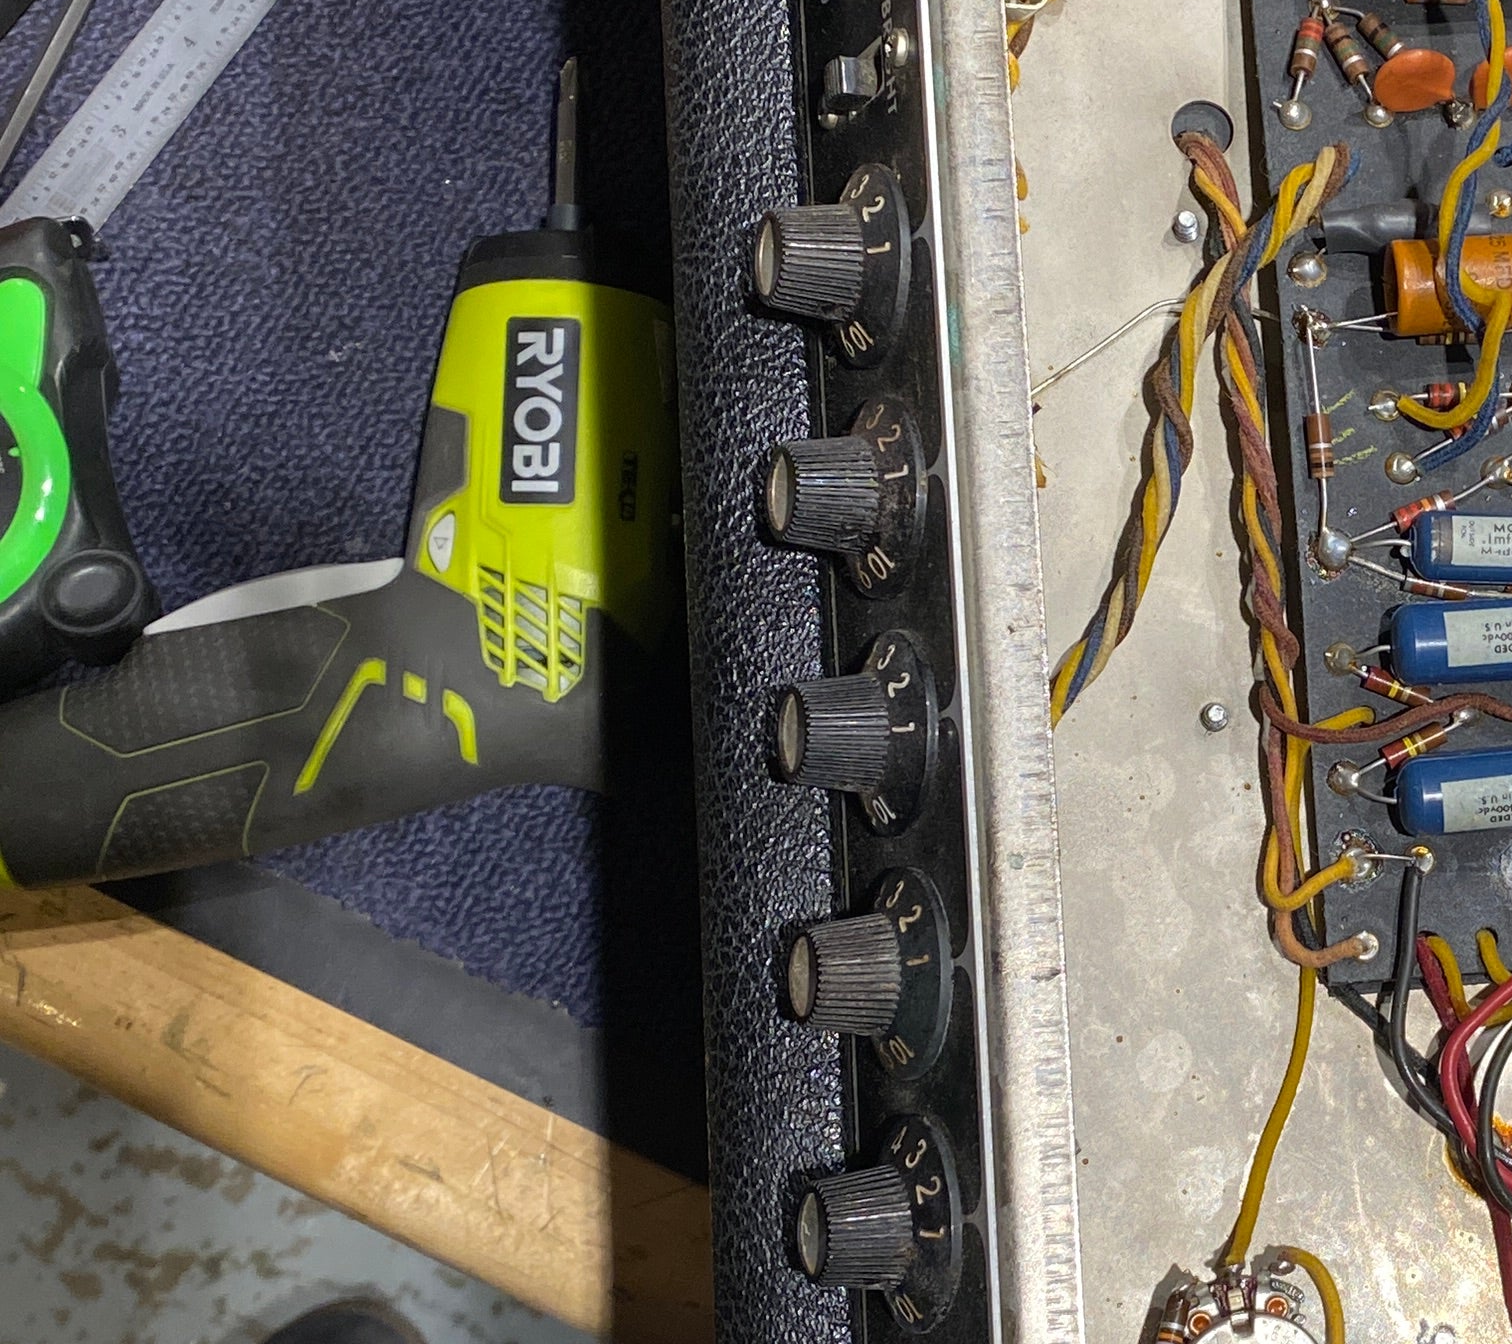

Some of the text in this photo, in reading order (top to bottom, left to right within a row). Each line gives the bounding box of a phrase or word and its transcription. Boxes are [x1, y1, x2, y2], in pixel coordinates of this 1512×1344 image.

[861, 195, 886, 224] 2
[866, 240, 892, 256] 1
[511, 328, 564, 492] RYOBI
[877, 424, 902, 454] 2
[884, 463, 910, 481] 1
[888, 672, 911, 699] 2
[891, 721, 915, 734] 1
[898, 904, 923, 934] 2
[906, 953, 930, 967] 1
[904, 1138, 927, 1170] 3
[915, 1175, 941, 1206] 2
[919, 1226, 945, 1241] 1
